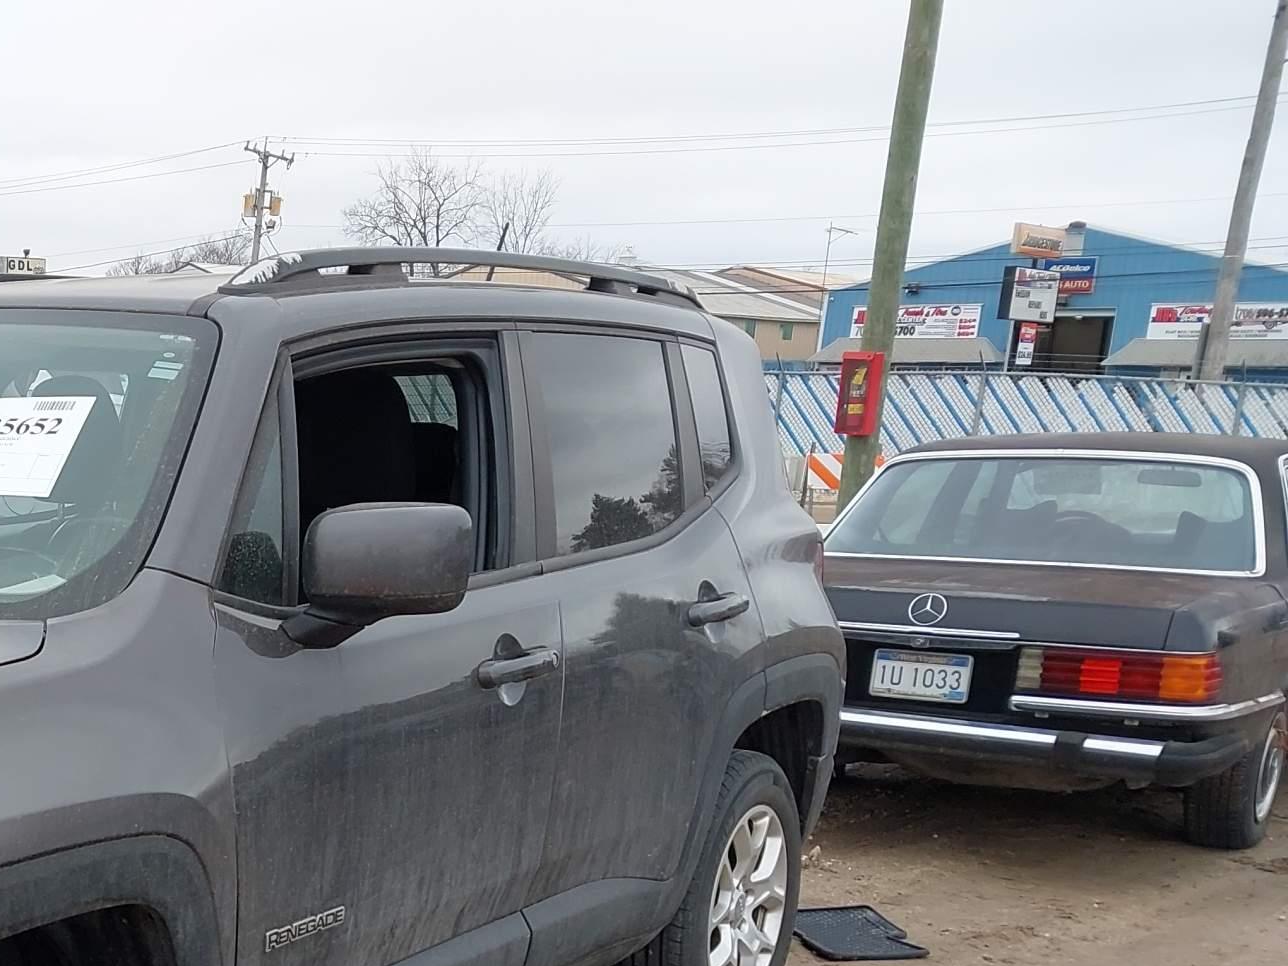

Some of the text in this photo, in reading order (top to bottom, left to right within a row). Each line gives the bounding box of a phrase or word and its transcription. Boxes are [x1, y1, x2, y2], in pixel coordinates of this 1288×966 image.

[8, 259, 33, 271] GDL
[1048, 264, 1091, 272] ACDelco
[1063, 280, 1089, 288] AUTO
[880, 664, 962, 691] 1U 1033
[265, 906, 345, 952] RENEGADE
